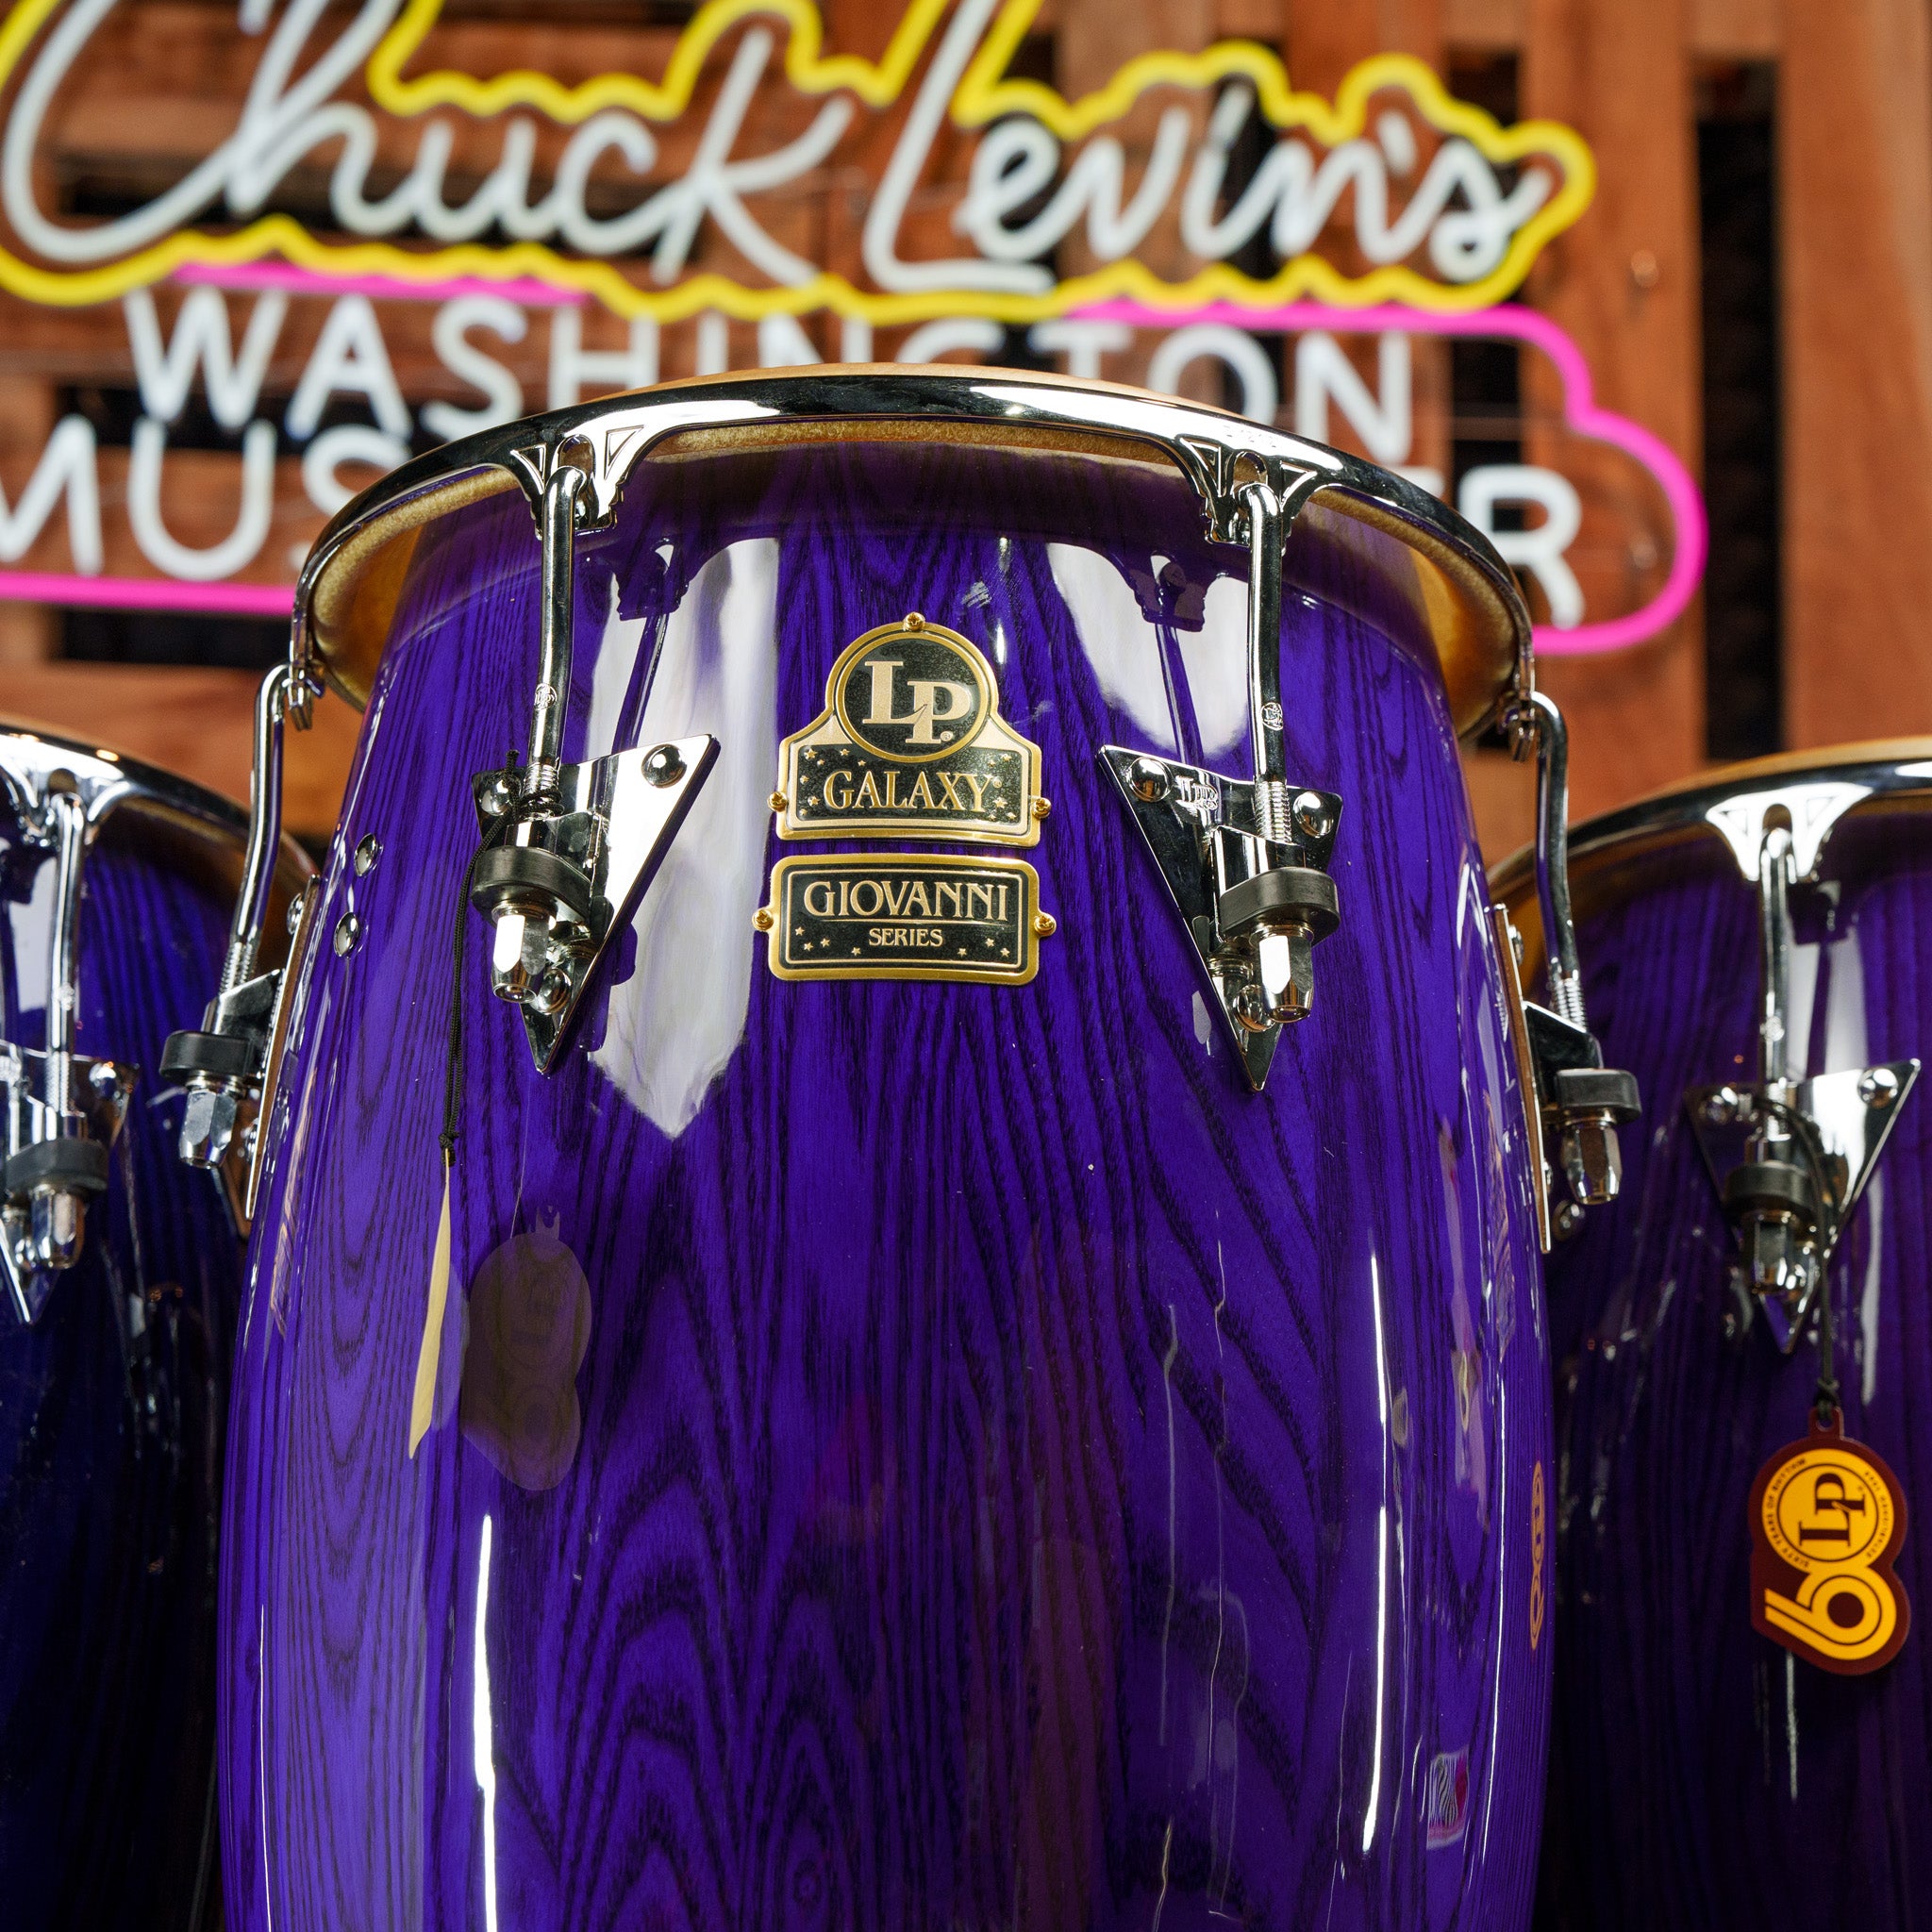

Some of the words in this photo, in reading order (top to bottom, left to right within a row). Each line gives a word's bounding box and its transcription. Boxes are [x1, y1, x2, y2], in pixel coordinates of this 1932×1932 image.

[0, 0, 856, 287] Chuck
[863, 0, 1556, 294] Levin's
[861, 659, 971, 743] LP
[823, 769, 995, 814] GALAXY
[803, 879, 1008, 922] GIOVANNI
[867, 926, 943, 947] SERIES
[1798, 1472, 1866, 1546] LP
